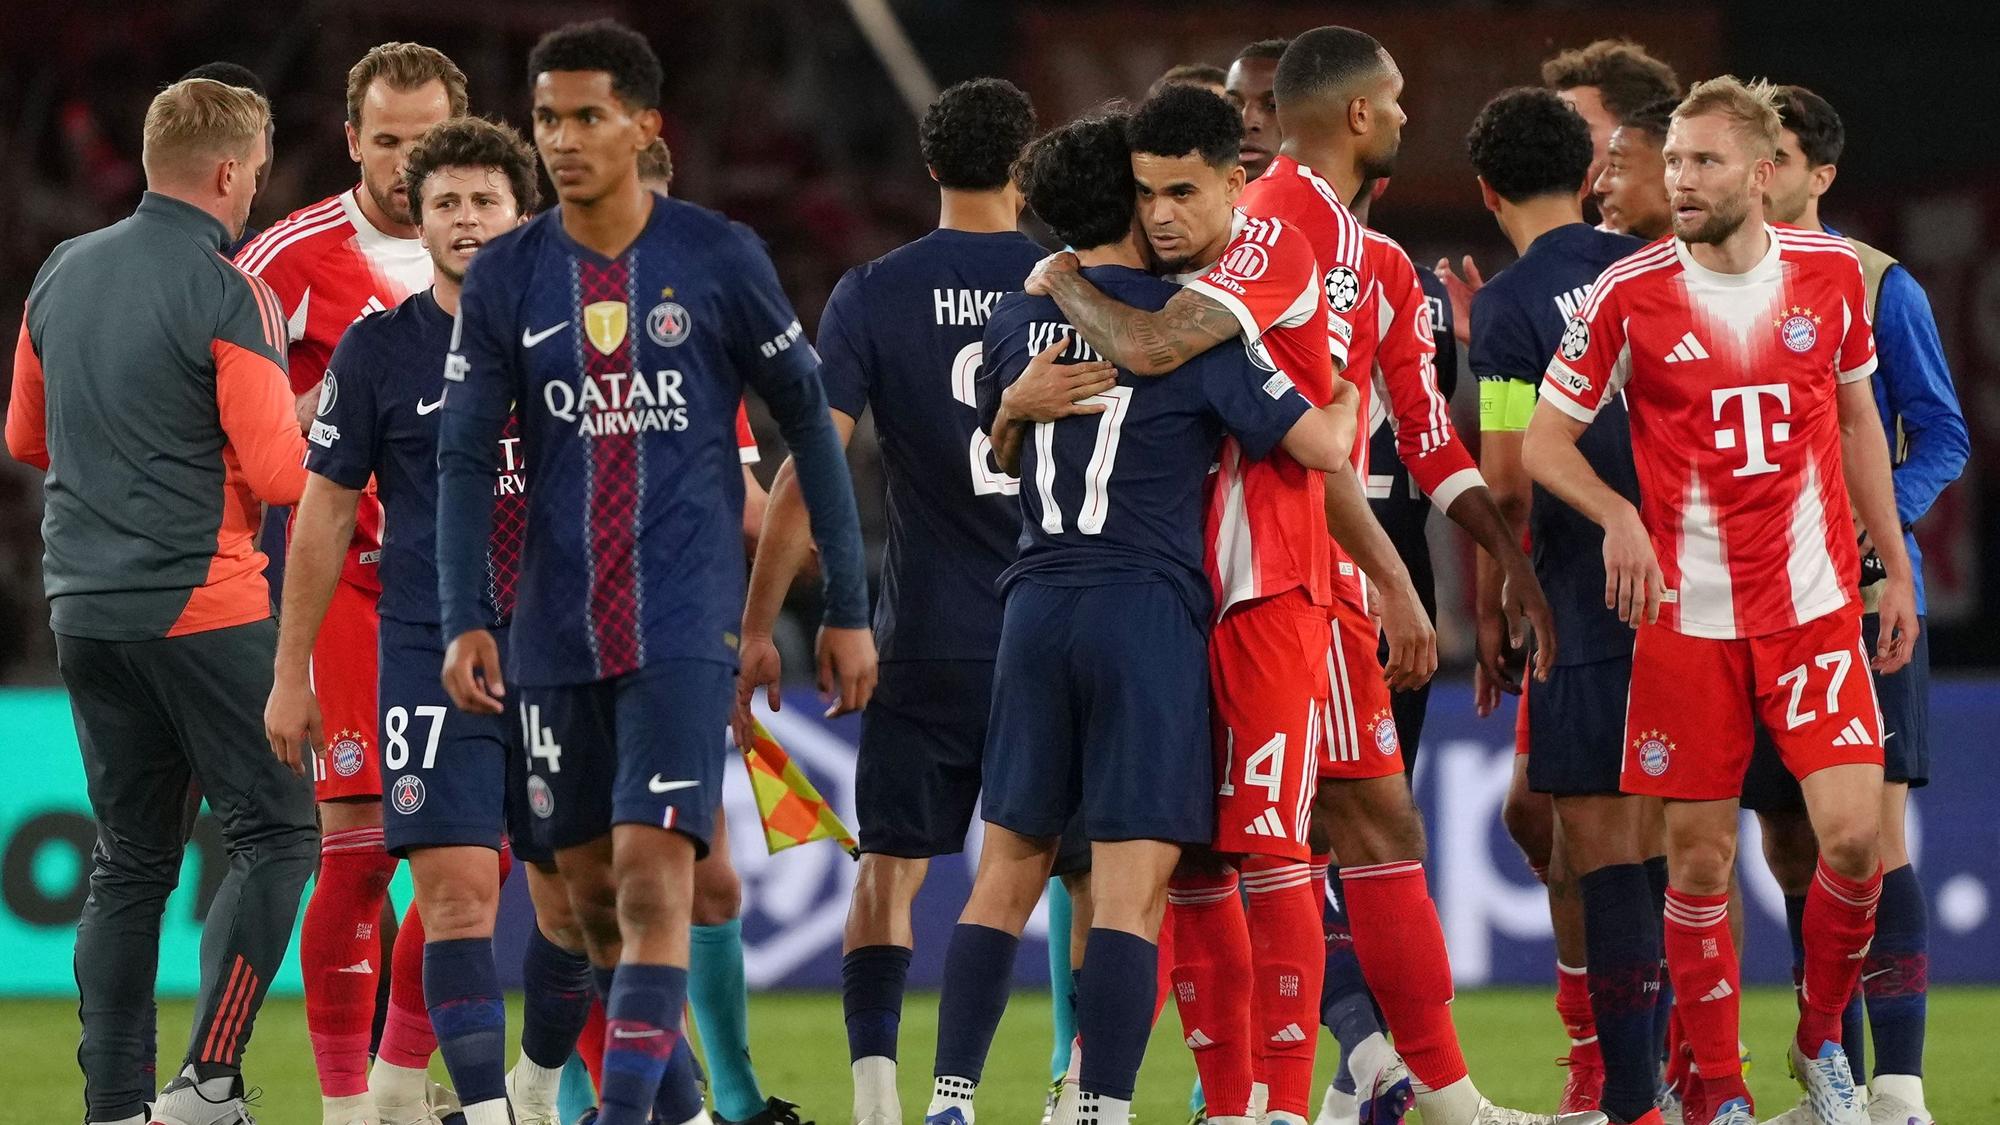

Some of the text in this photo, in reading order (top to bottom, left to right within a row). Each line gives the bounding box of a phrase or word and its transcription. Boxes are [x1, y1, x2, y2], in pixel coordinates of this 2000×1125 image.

[543, 369, 687, 423] QATAR
[577, 407, 689, 438] AIRWAYS
[1034, 386, 1133, 535] 17
[1777, 649, 1852, 731] 27
[385, 705, 448, 771] 87
[1219, 726, 1287, 803] 14
